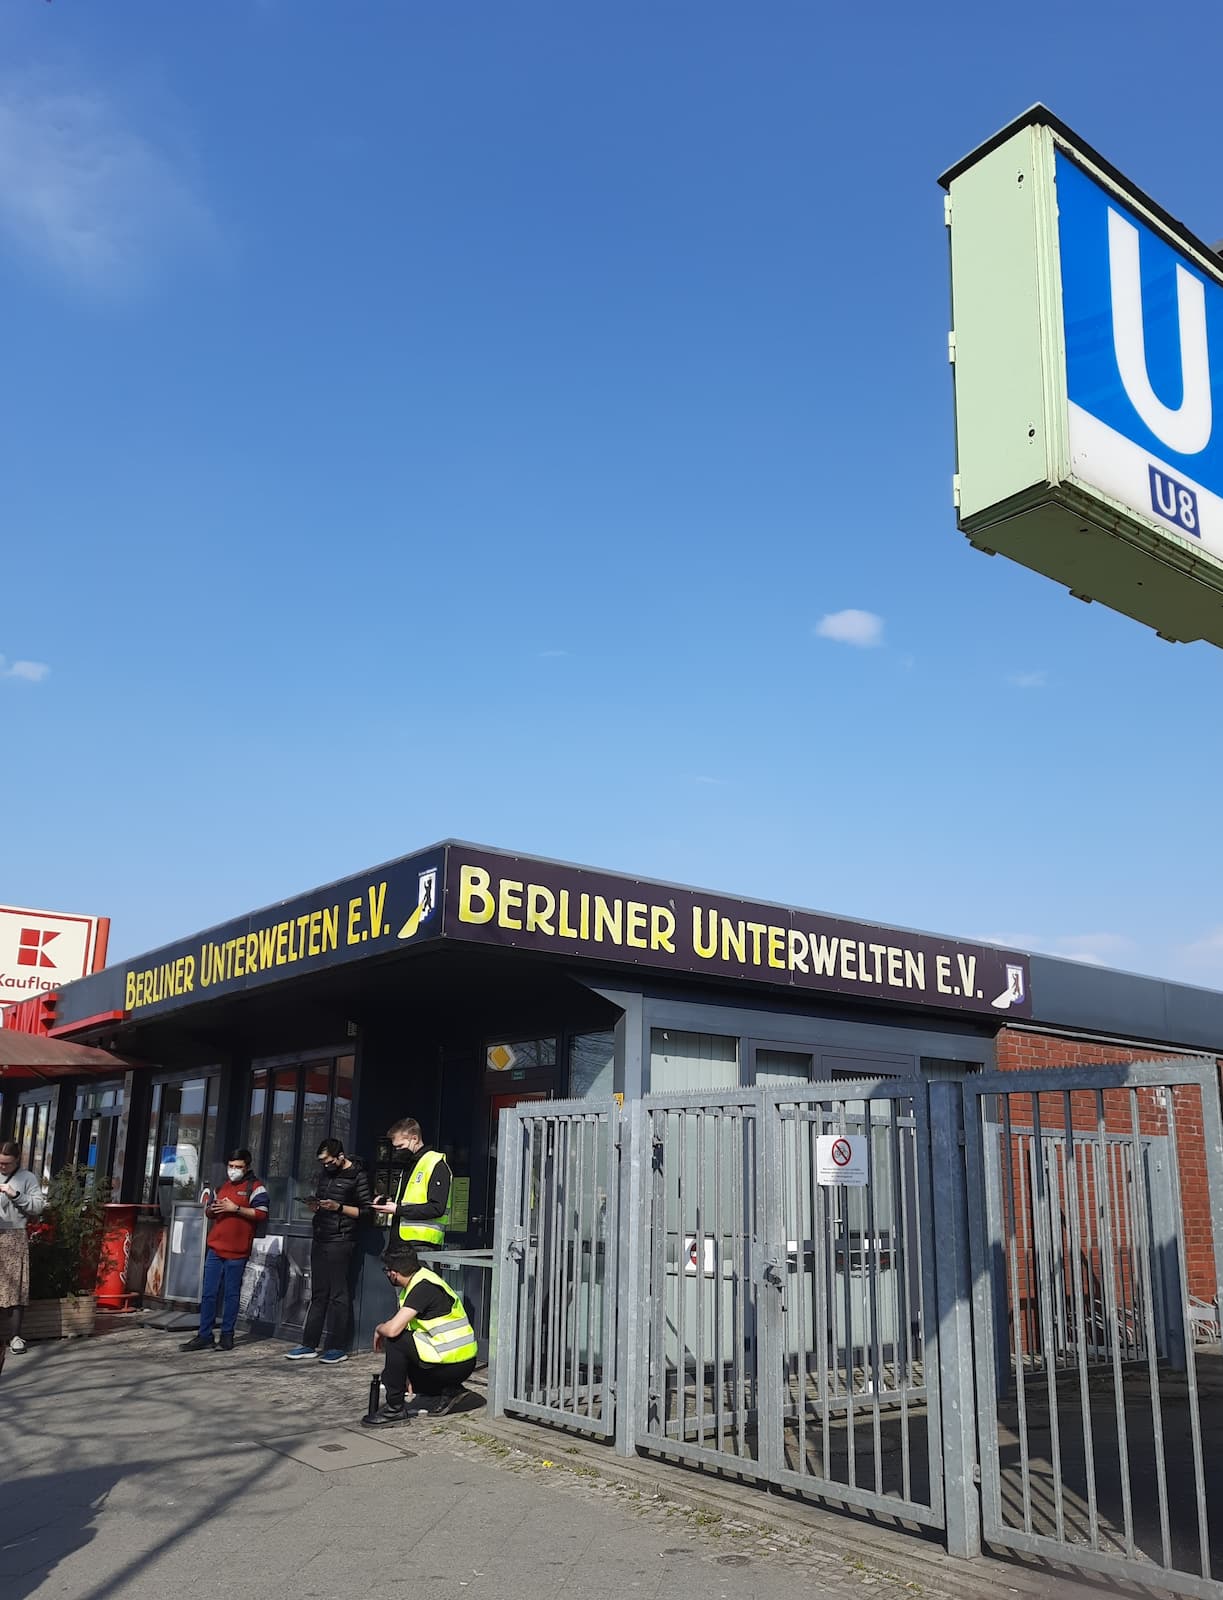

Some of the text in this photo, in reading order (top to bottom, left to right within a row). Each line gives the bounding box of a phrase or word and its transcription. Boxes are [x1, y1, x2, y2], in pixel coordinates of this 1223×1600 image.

[1108, 206, 1212, 455] U
[1154, 473, 1196, 530] U8
[125, 955, 194, 1011] BERLINER
[200, 905, 339, 987] UNTERWELTEN
[458, 864, 676, 954] BERLINER
[692, 906, 925, 990] UNTERWELTEN
[0, 973, 62, 991] Kauflan
